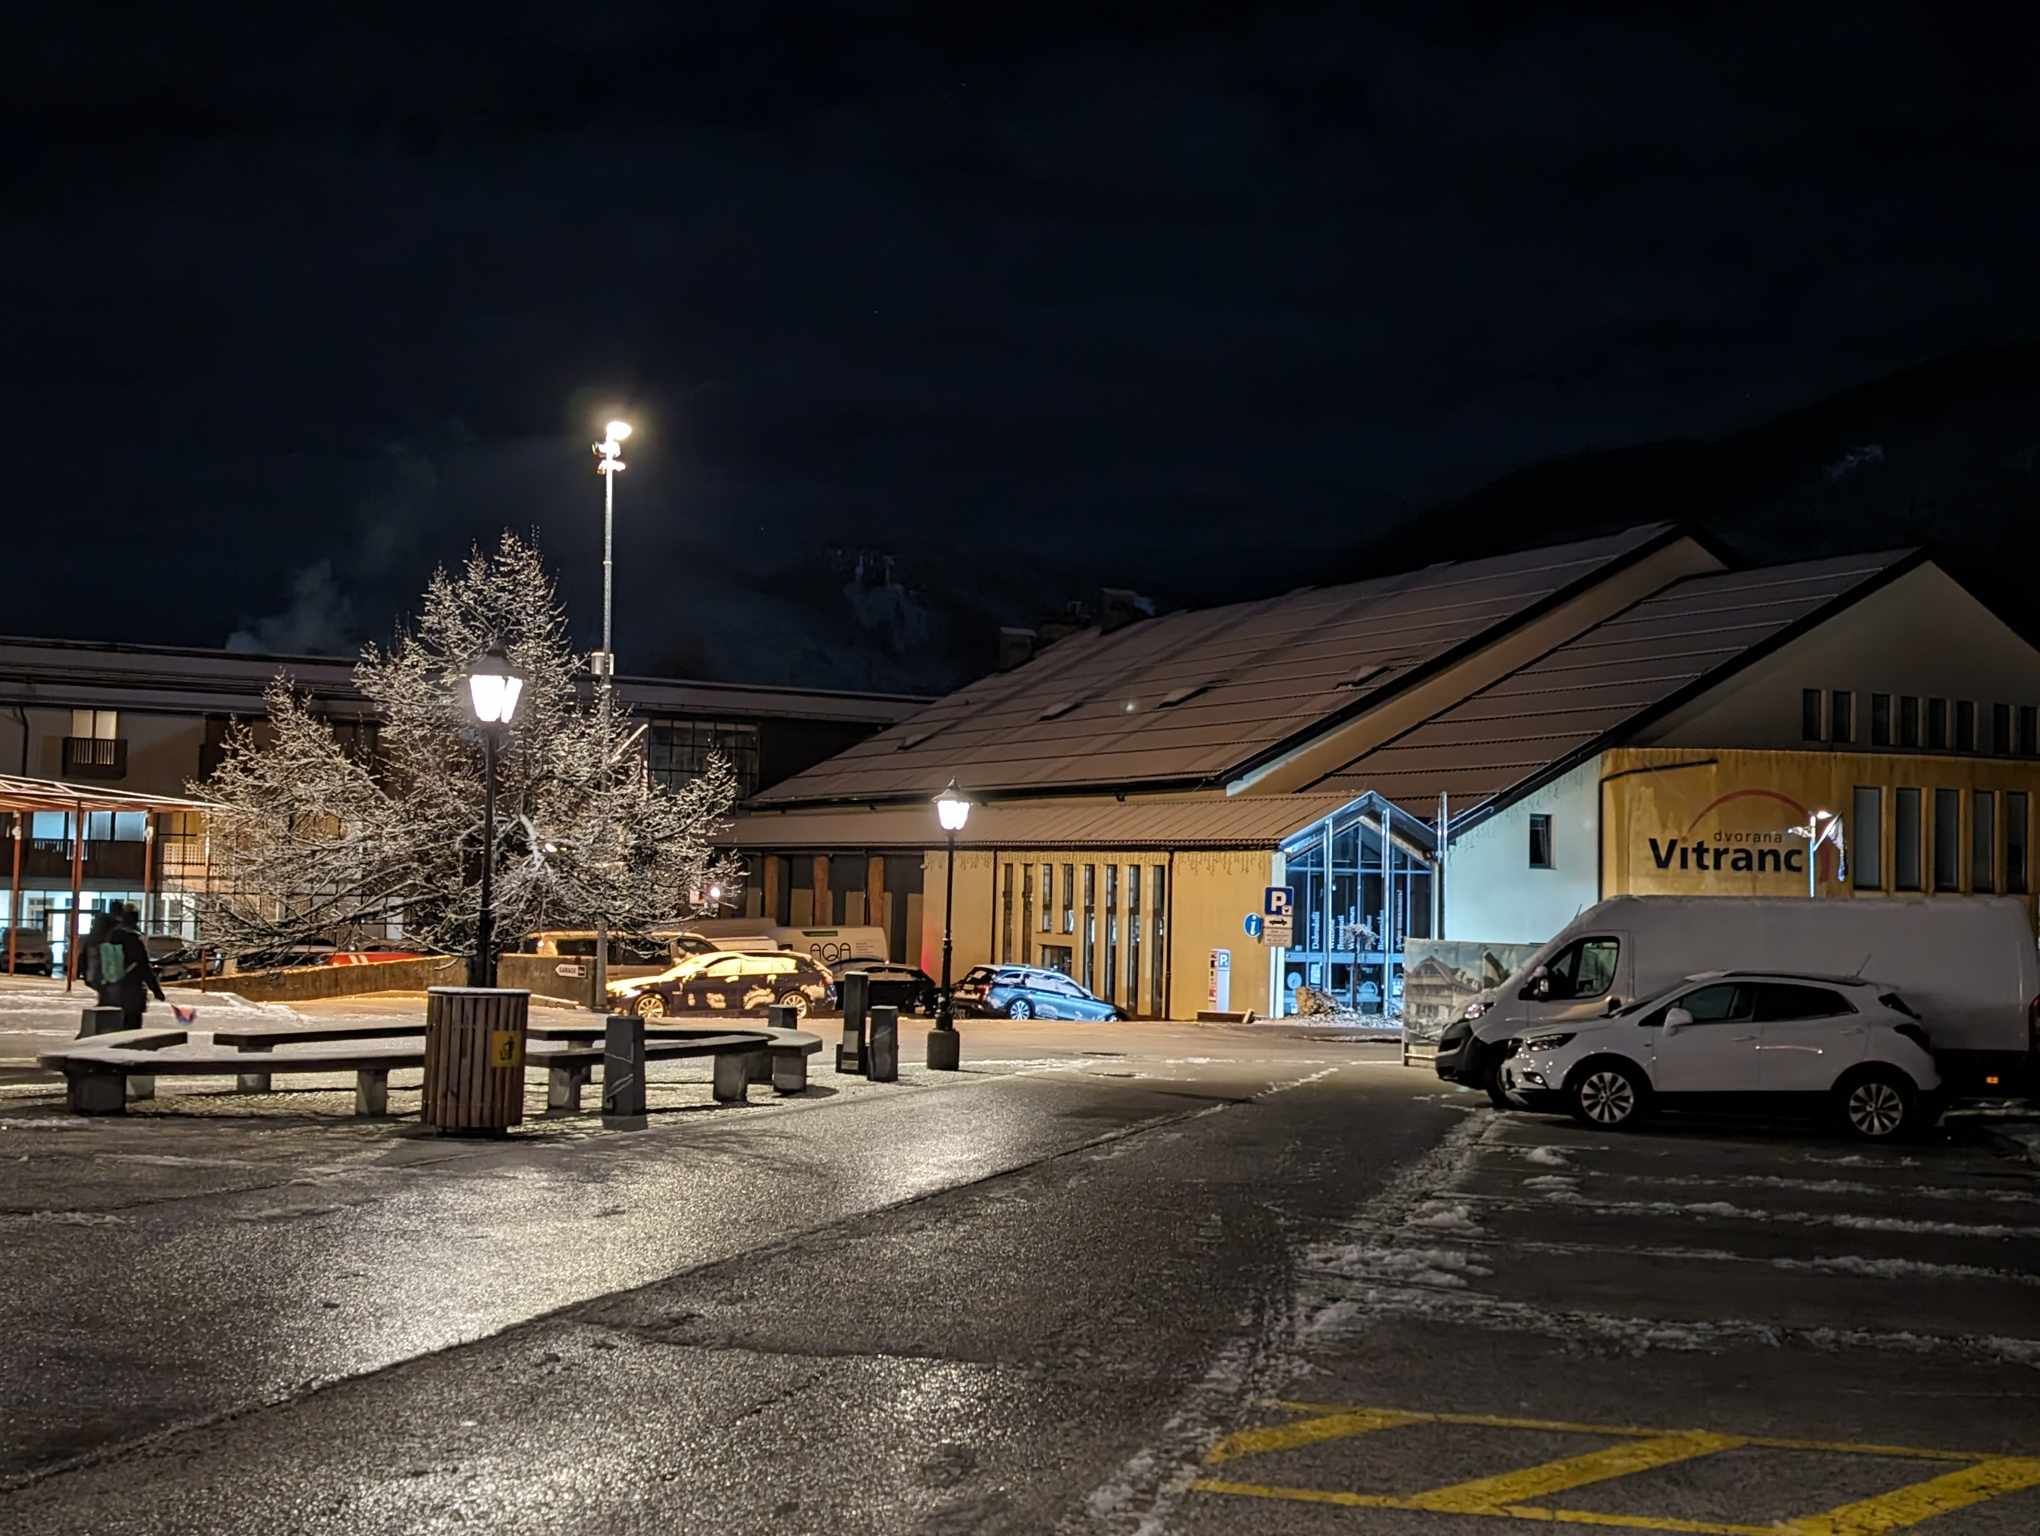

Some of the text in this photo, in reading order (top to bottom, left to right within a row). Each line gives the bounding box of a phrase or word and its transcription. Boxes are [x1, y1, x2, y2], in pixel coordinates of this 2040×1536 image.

[1713, 829, 1783, 843] dvorana
[1648, 837, 1803, 872] Vitranc
[1271, 891, 1287, 911] P
